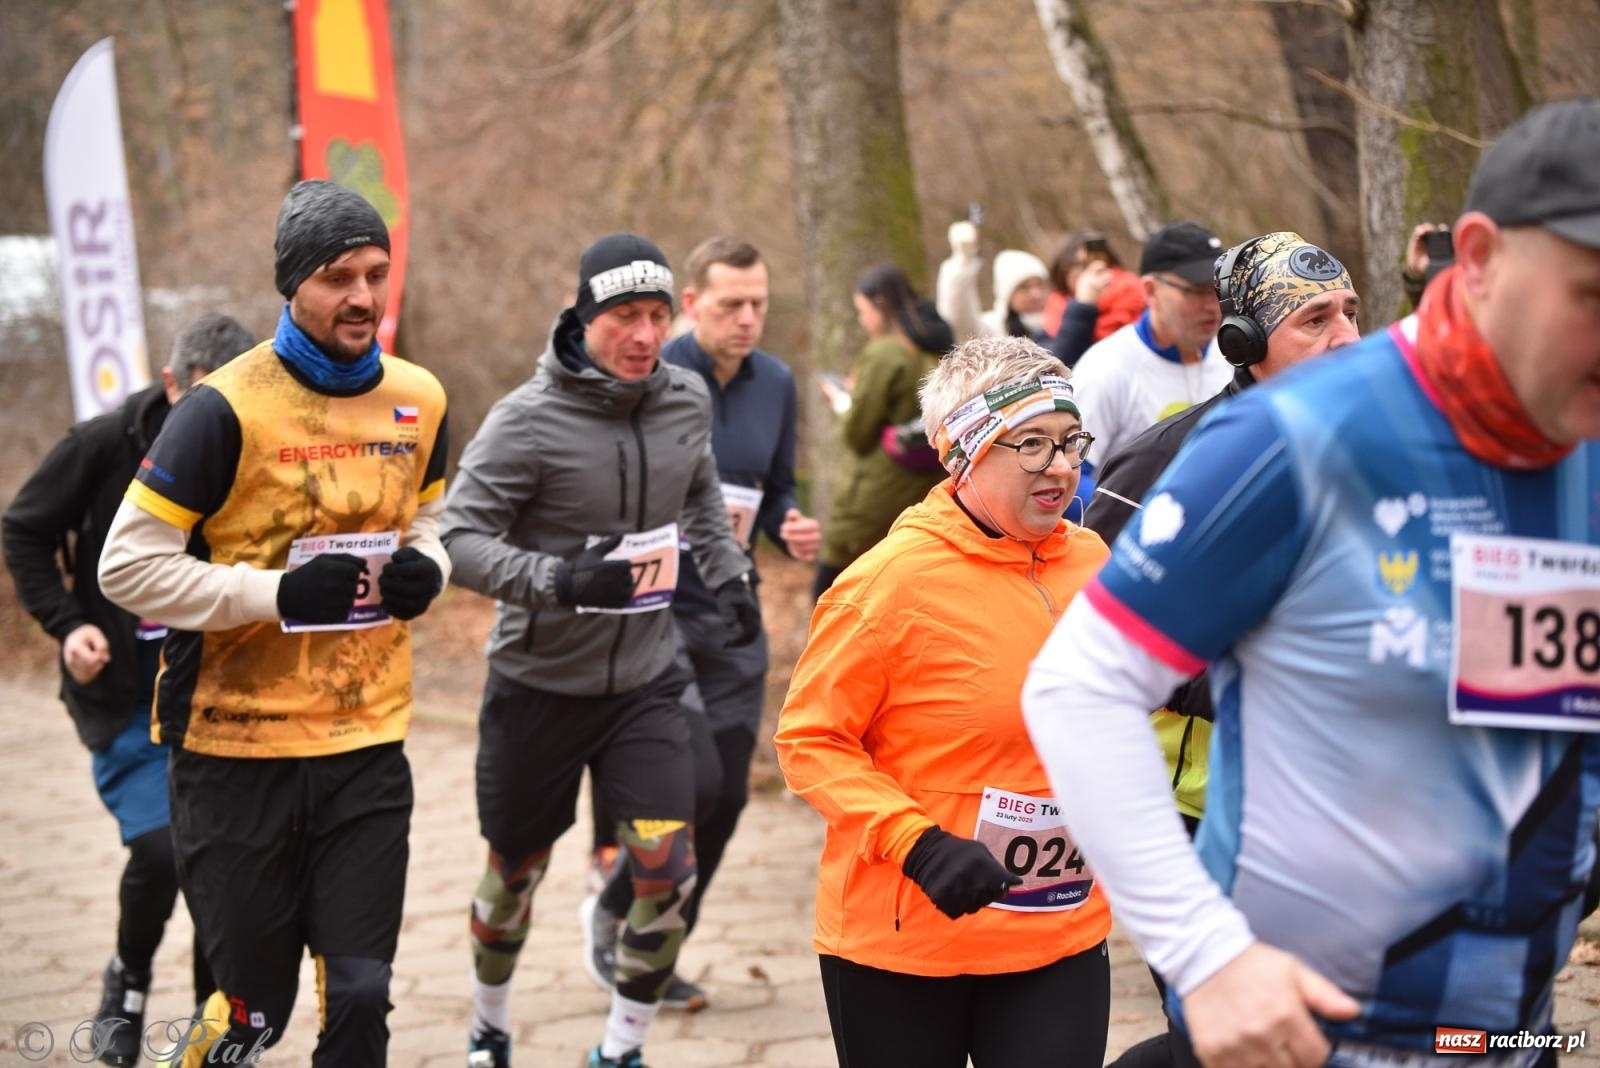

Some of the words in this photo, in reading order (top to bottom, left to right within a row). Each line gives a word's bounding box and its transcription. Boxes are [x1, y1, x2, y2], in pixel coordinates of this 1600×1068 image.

[1505, 604, 1600, 674] 138
[998, 797, 1036, 815] BIEG
[1041, 804, 1063, 816] Tw
[1005, 813, 1017, 822] luty
[1004, 835, 1086, 877] 024
